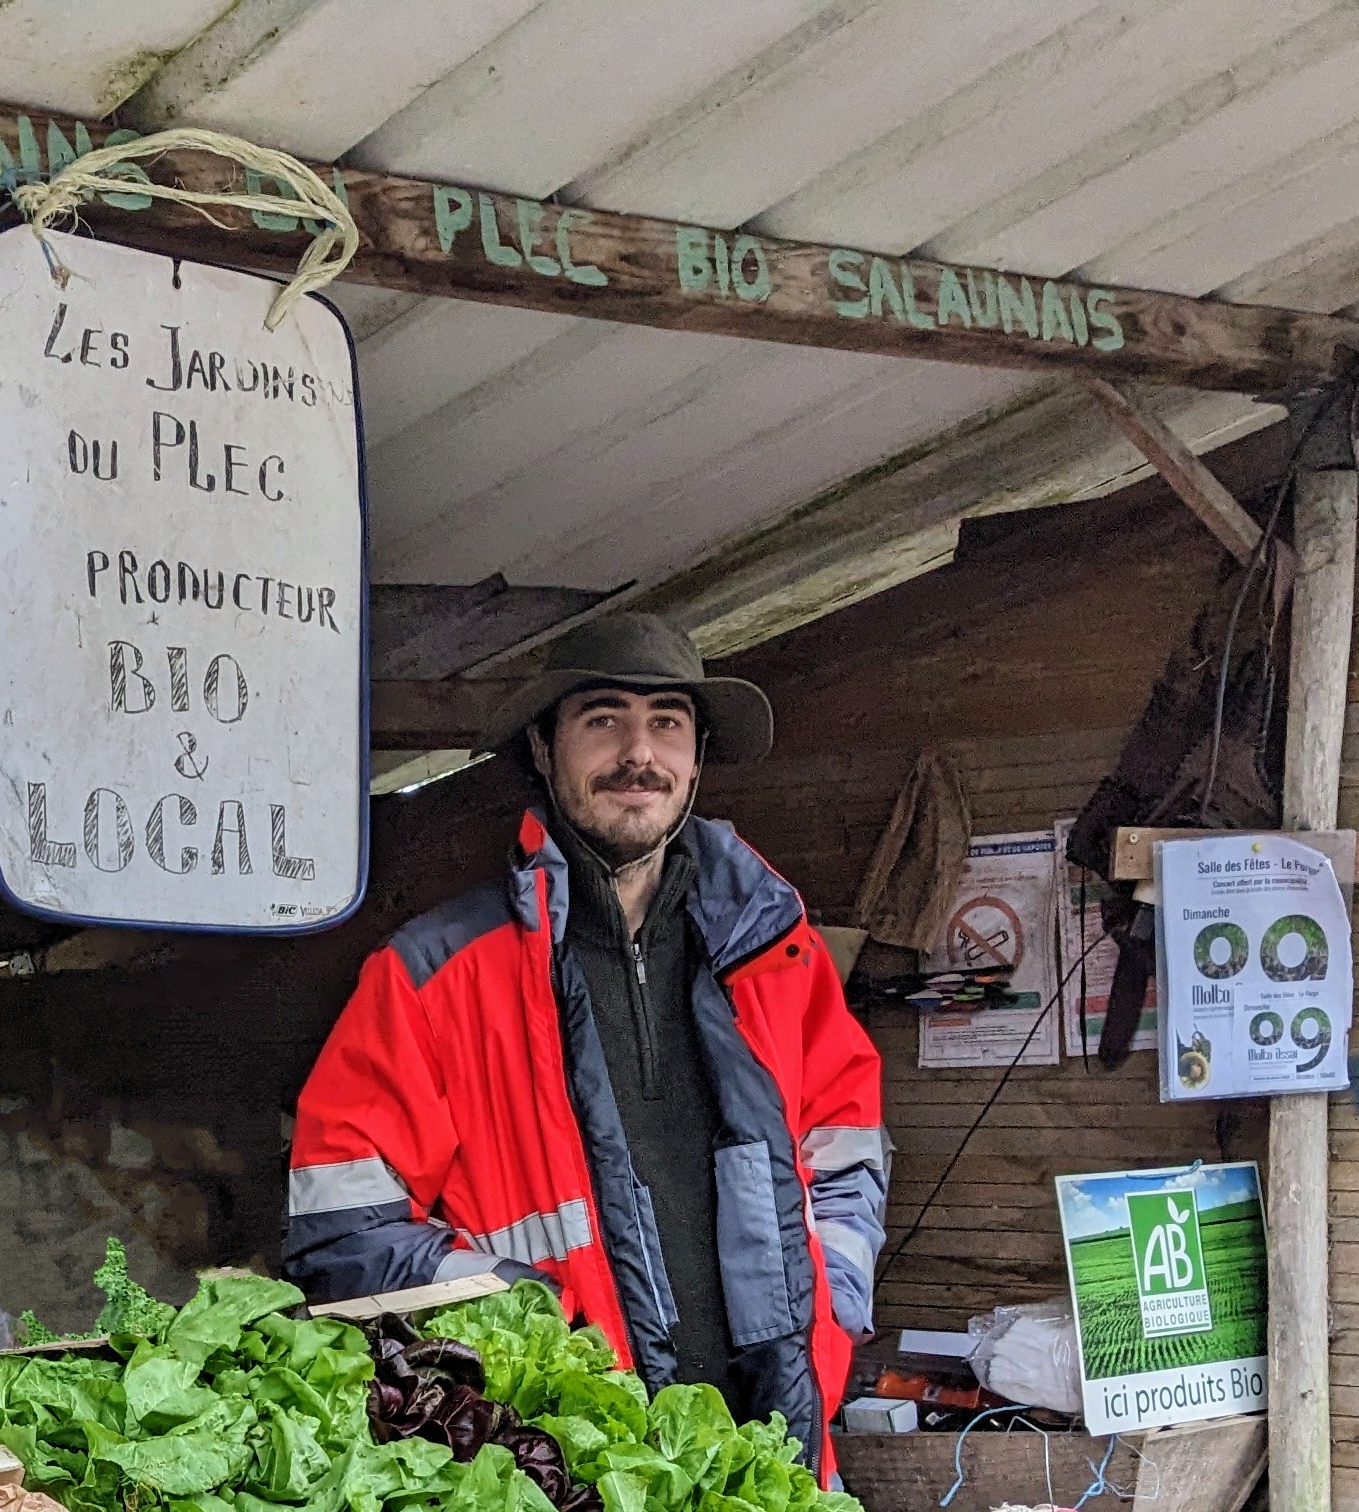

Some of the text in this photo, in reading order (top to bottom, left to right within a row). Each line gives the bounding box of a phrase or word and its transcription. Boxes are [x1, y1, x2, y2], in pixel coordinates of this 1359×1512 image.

[433, 184, 608, 286] PLEC
[676, 227, 771, 301] BIO
[828, 249, 1124, 351] SALAUNAIS
[68, 411, 284, 501] DU PLEC
[87, 550, 340, 634] PRODUCTEUR
[108, 641, 248, 723] BIO
[174, 732, 209, 781] &
[28, 782, 315, 880] LOCAL
[1198, 861, 1222, 874] Salle
[1225, 860, 1241, 872] des
[1243, 858, 1270, 871] Fêtes
[1281, 858, 1291, 869] Le
[1183, 907, 1230, 921] Dimanche
[1192, 984, 1230, 1006] Molto
[1249, 1006, 1332, 1074] 09
[1144, 1224, 1192, 1291] AB
[1143, 1294, 1208, 1313] AGRICULTURE
[1144, 1309, 1210, 1329] BIOLOGIQUE
[1103, 1366, 1263, 1423] ici produits Bio
